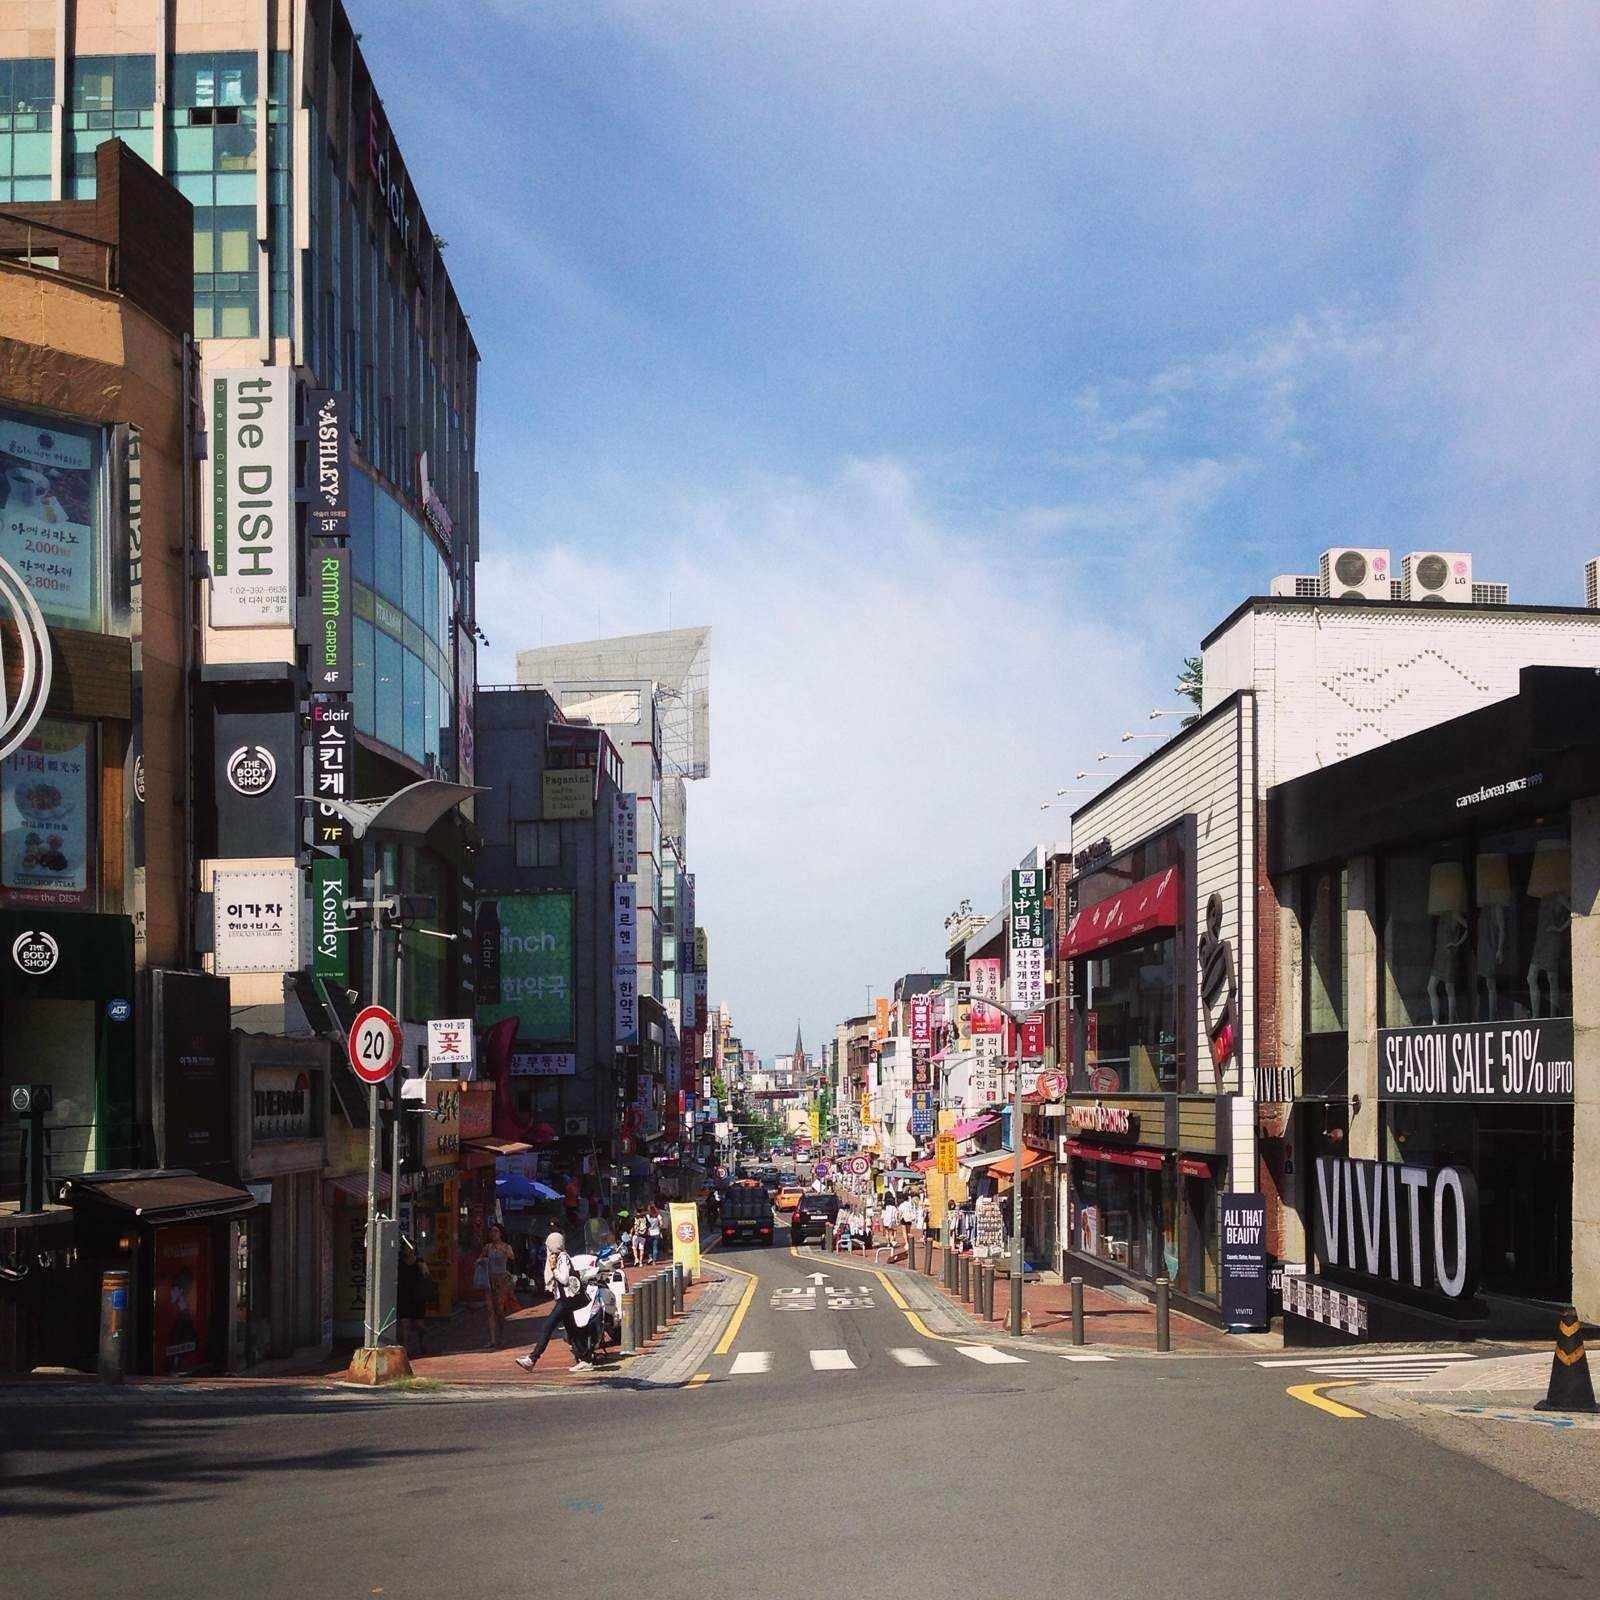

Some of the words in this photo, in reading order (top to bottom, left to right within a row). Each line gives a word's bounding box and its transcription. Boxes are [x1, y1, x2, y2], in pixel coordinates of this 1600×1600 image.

[238, 377, 273, 448] the
[318, 409, 338, 496] ASHLEY
[238, 465, 273, 576] DISH
[321, 519, 338, 531] 5F
[1374, 573, 1386, 582] LG
[324, 671, 339, 682] 4F
[314, 706, 350, 722] Eclair
[243, 760, 260, 769] THE
[237, 767, 268, 778] BODY
[238, 776, 267, 787] SHOP
[322, 827, 343, 841] 7F
[40, 892, 57, 903] the
[58, 893, 81, 905] DISH
[317, 878, 343, 959] Kosney
[29, 944, 46, 952] THE
[23, 951, 52, 960] BODY
[24, 959, 51, 968] SHOP
[363, 1030, 385, 1061] 20
[437, 1032, 462, 1054] 꽃
[1385, 1033, 1448, 1094] SEASON
[1452, 1031, 1495, 1094] SALE
[1501, 1028, 1545, 1094] 50%
[855, 1162, 865, 1170] 20
[1224, 1209, 1240, 1227] ALL
[1242, 1209, 1264, 1227] THAT
[1315, 1156, 1467, 1298] VIVITO
[1226, 1227, 1261, 1245] BEAUTY
